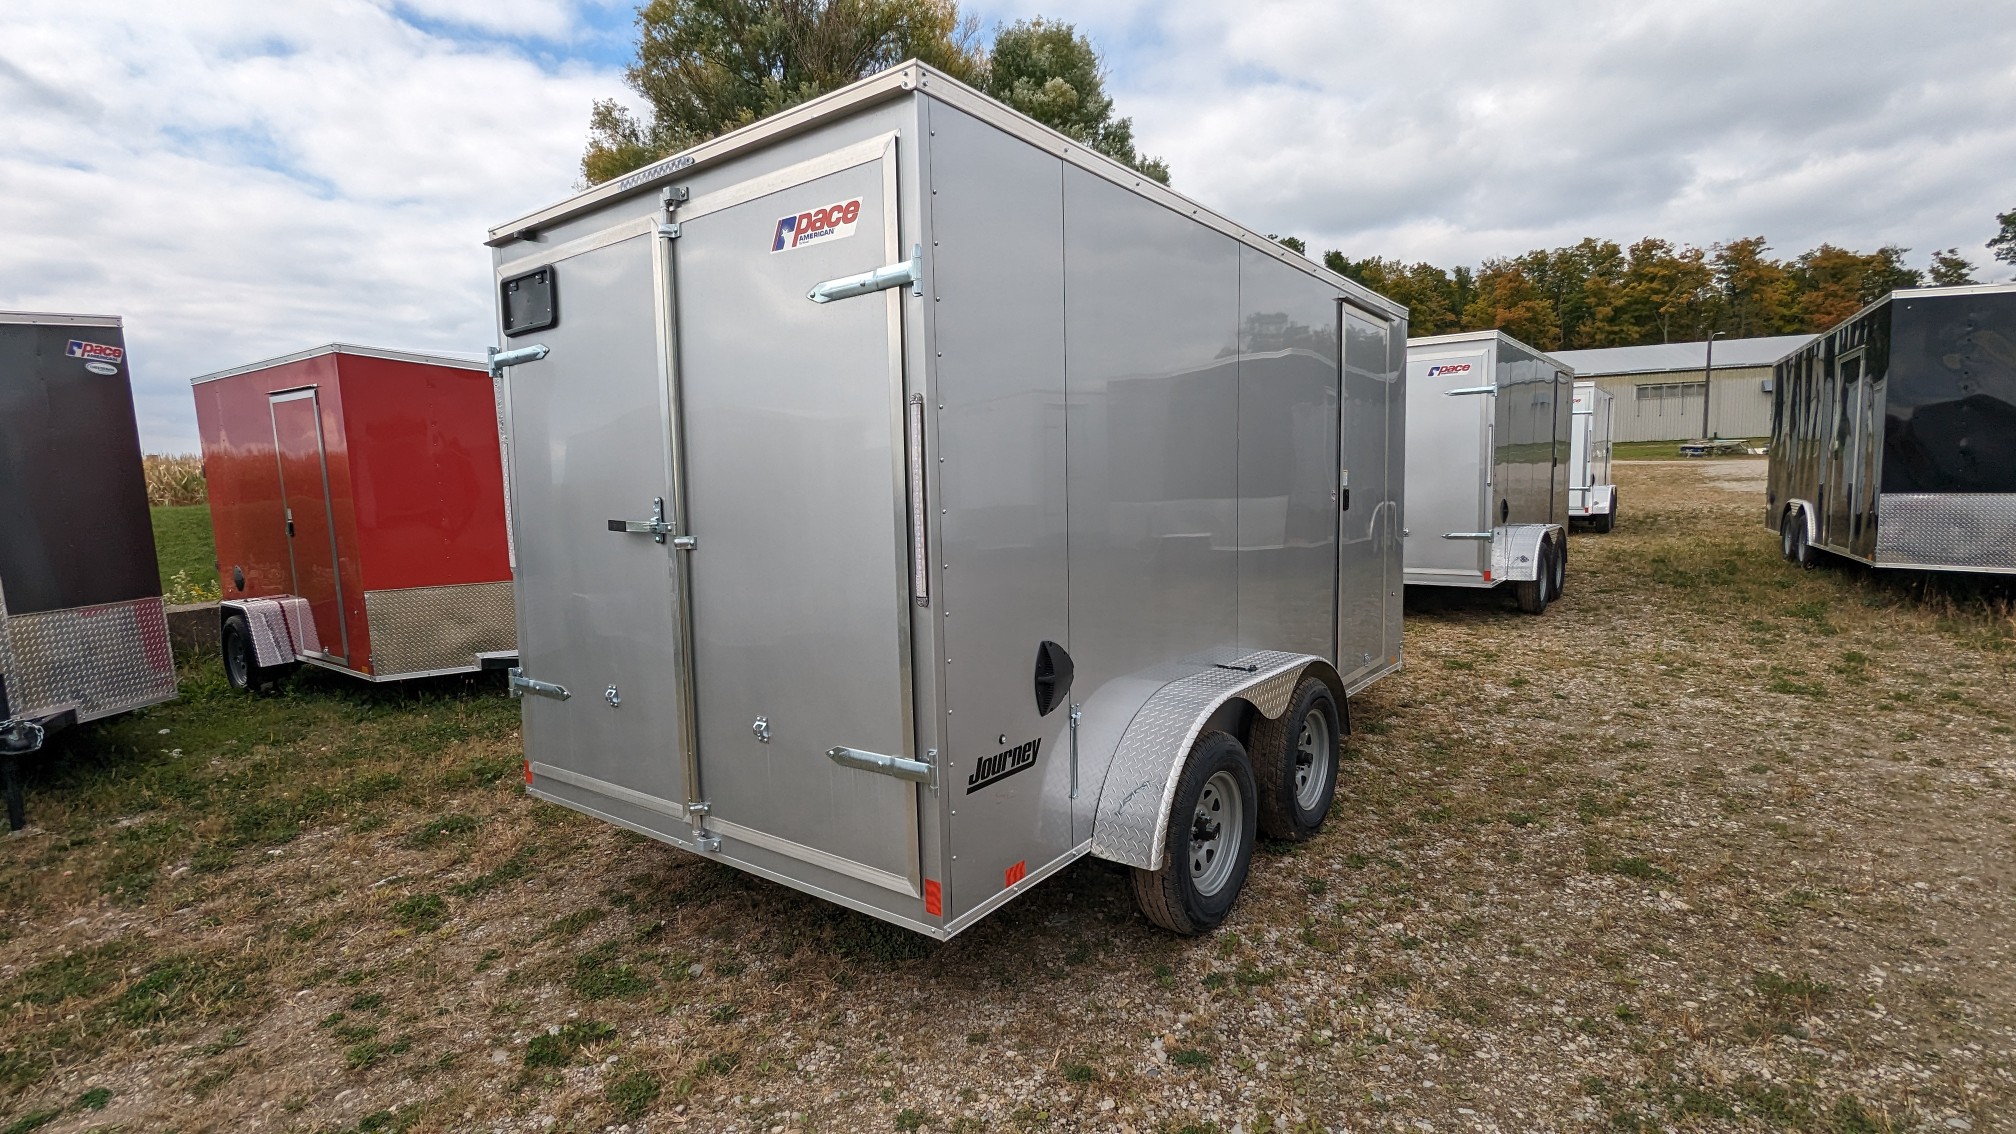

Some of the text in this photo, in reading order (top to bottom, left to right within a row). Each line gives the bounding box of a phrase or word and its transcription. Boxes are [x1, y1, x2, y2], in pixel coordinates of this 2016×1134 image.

[792, 200, 861, 248] pace
[799, 228, 835, 242] AMERICAN
[81, 343, 123, 357] pace
[1437, 364, 1471, 376] pace
[966, 737, 1042, 795] Journey
